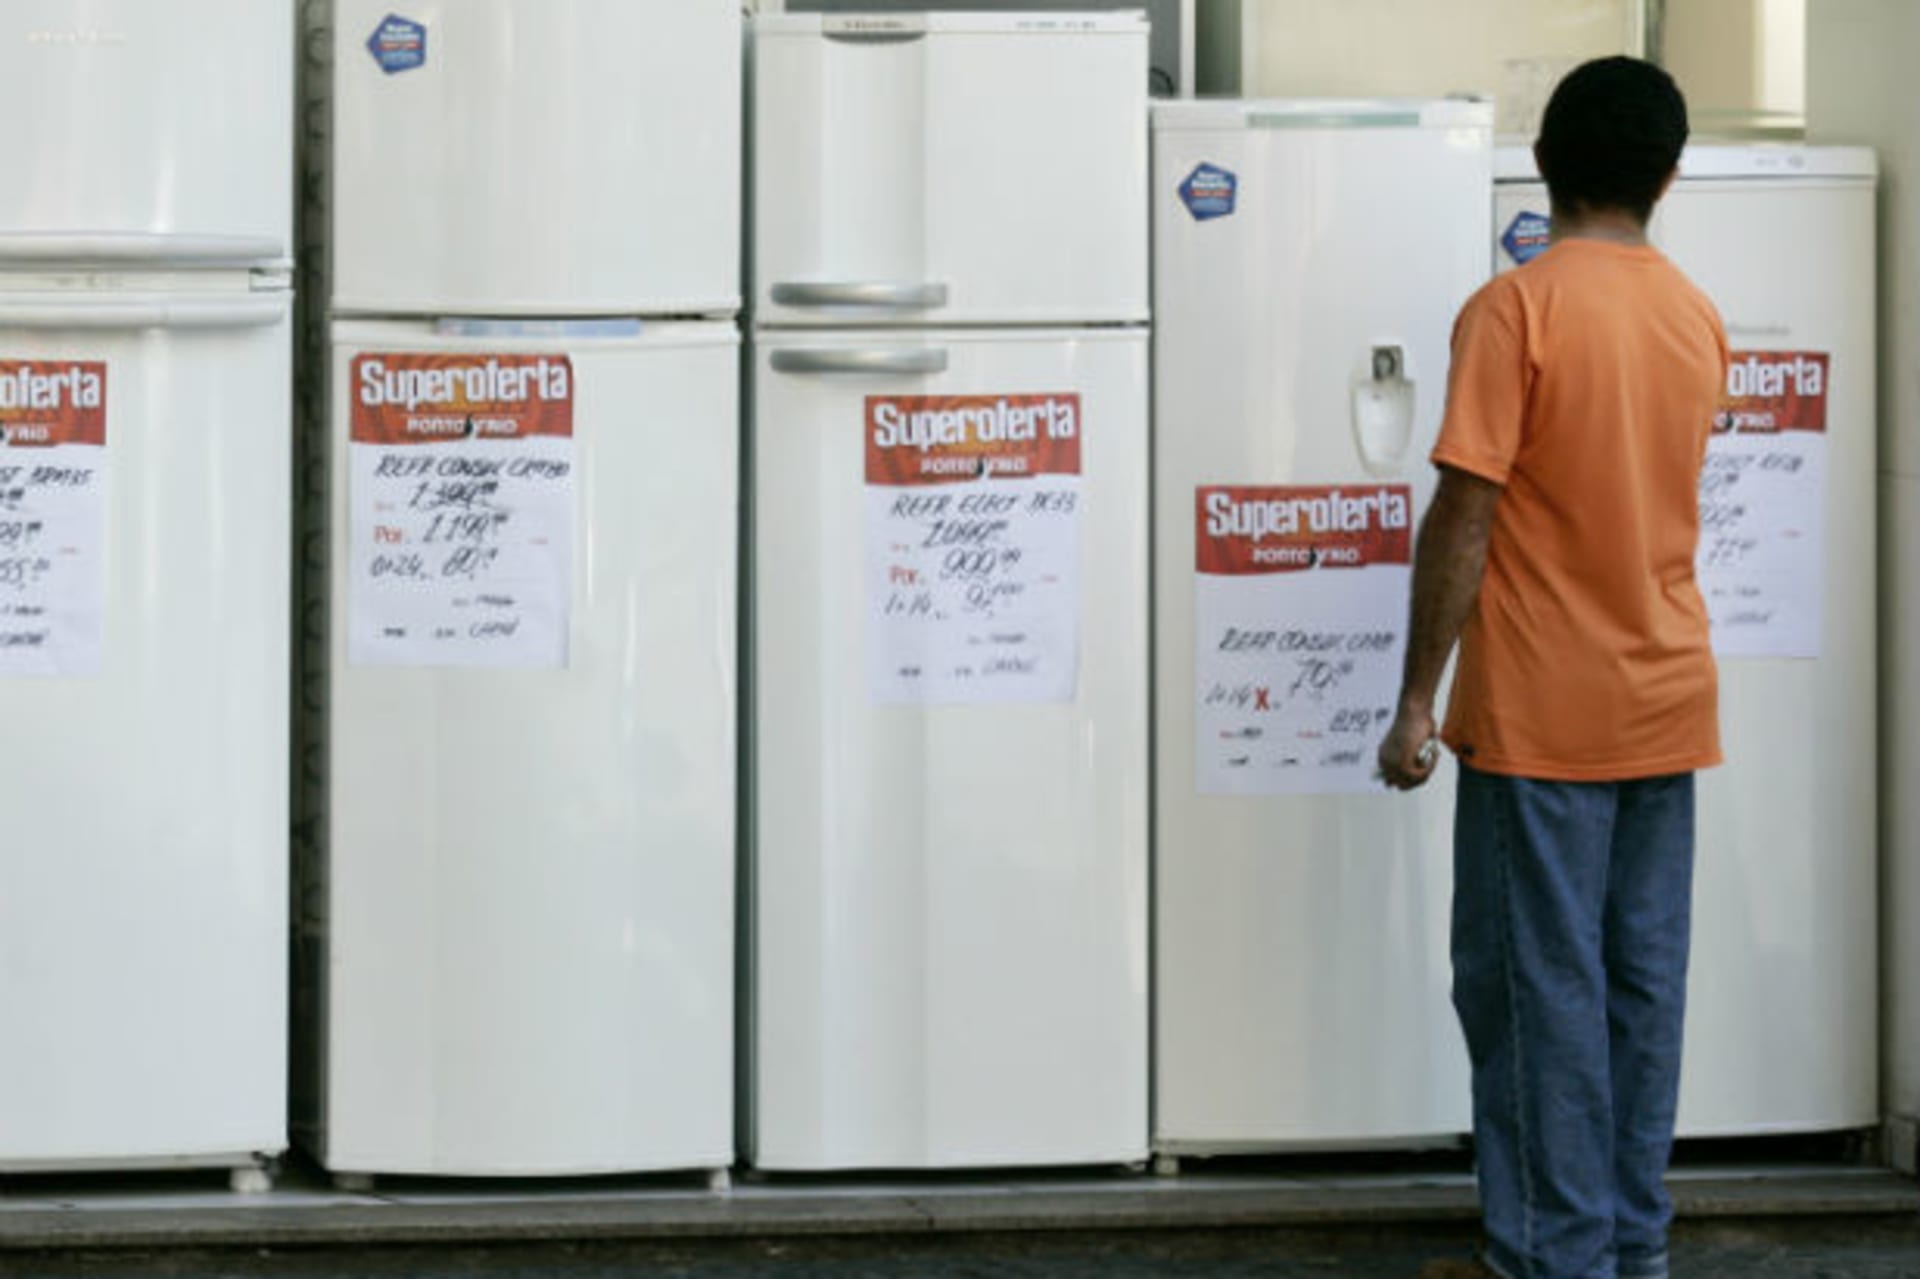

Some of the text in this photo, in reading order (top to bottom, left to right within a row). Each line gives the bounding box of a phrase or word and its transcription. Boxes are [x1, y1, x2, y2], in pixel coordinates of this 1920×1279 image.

[360, 358, 568, 411] Superoferta
[873, 398, 1075, 452] Superoferta
[1206, 489, 1408, 543] Superoferta
